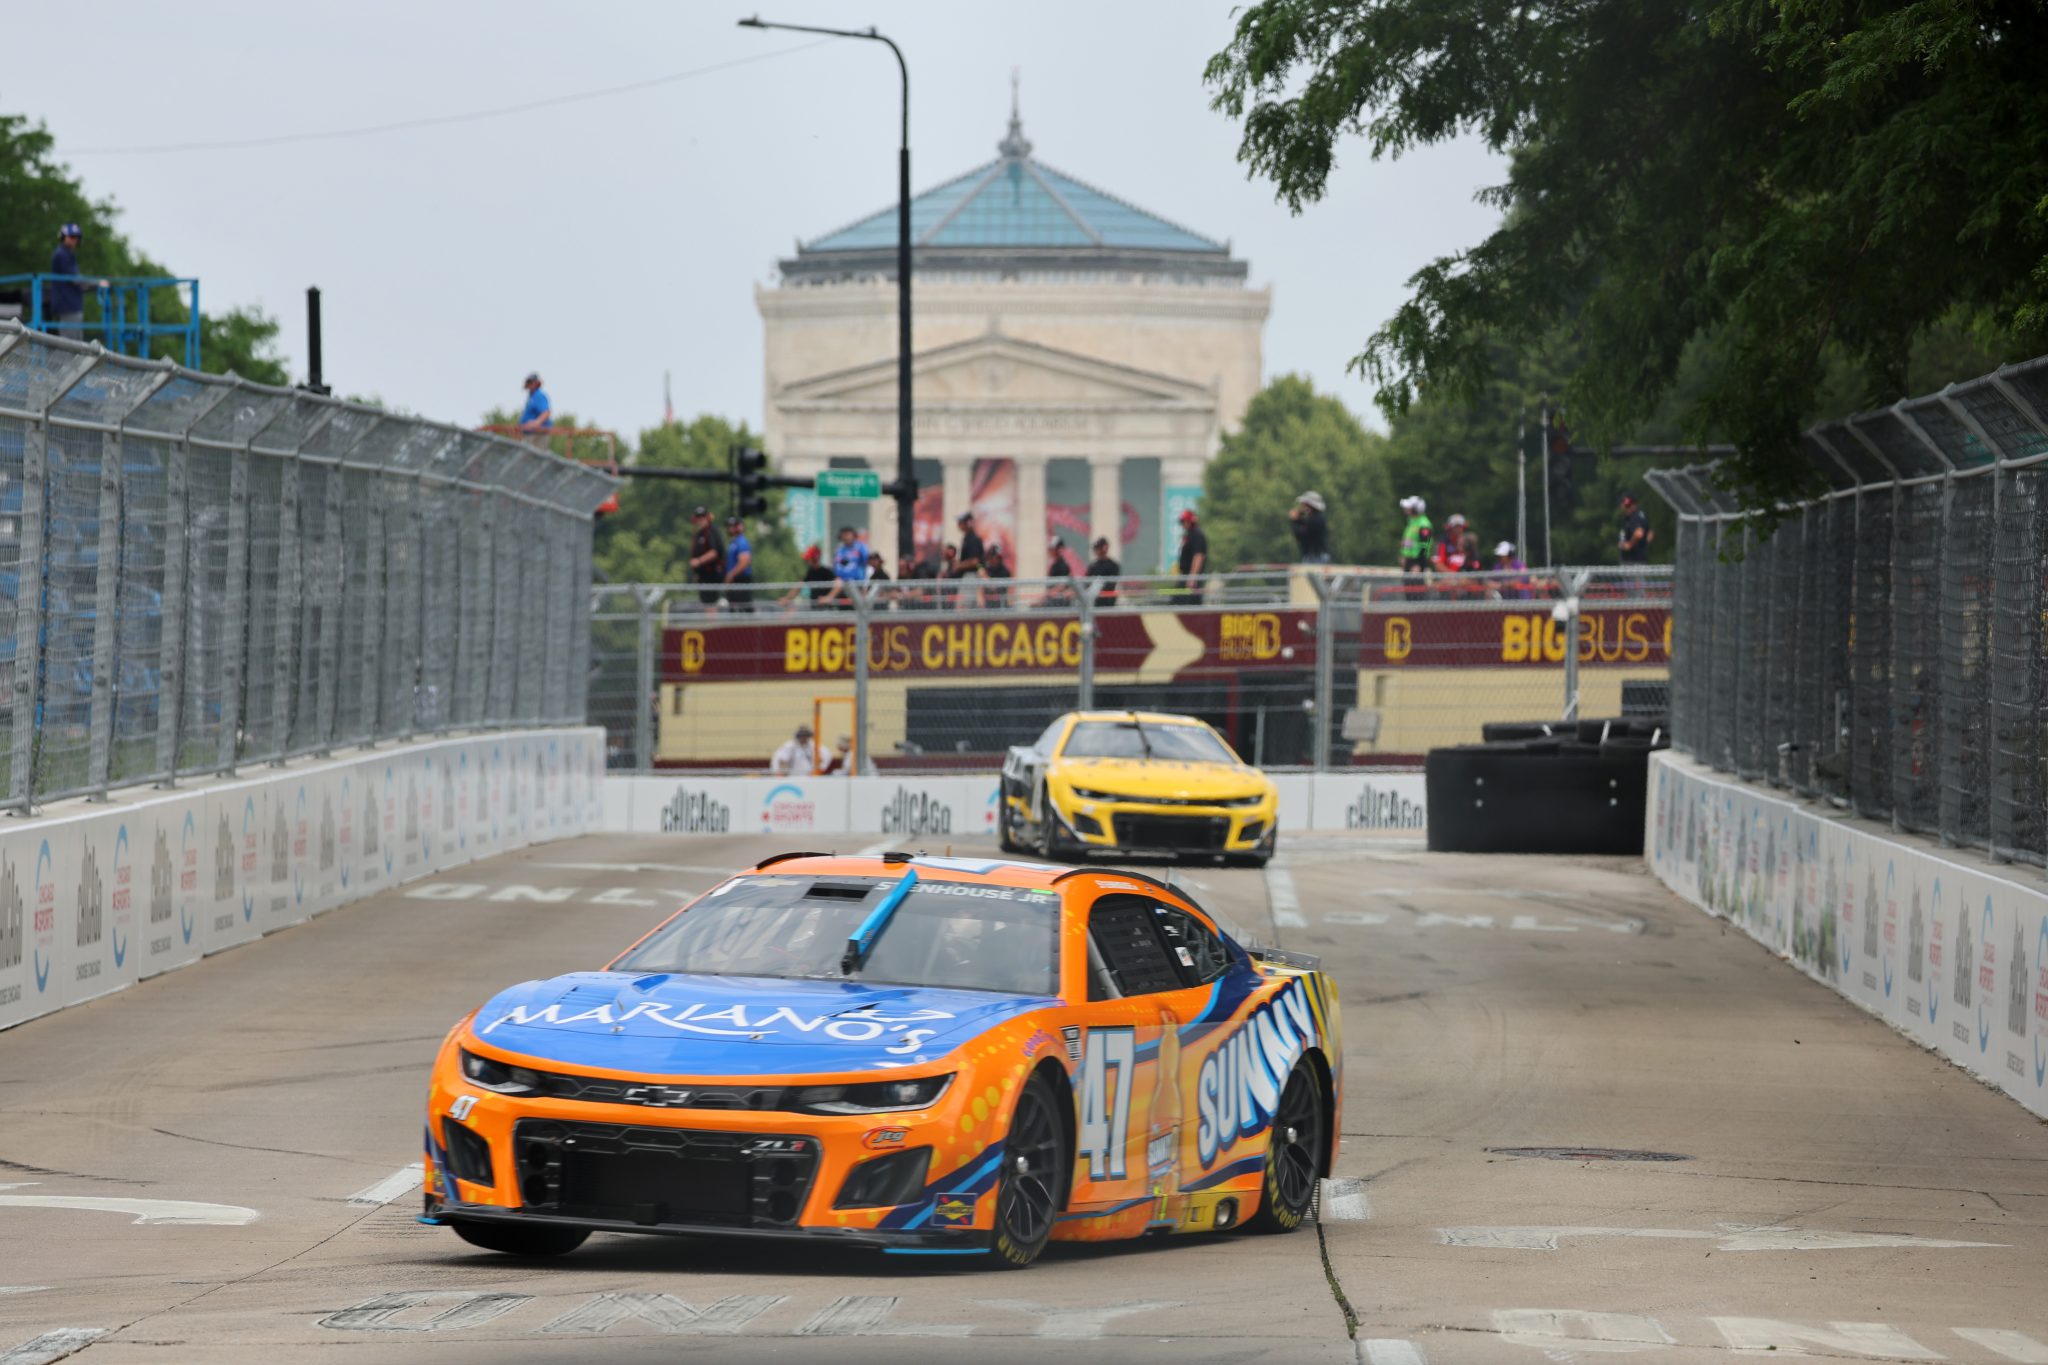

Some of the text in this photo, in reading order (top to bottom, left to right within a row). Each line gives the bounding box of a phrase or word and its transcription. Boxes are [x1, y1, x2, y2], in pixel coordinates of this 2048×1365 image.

[921, 621, 1083, 667] CHICAGO
[1017, 892, 1048, 904] JR
[482, 1001, 955, 1055] MARIANO'S
[1199, 978, 1317, 1168] SUNNY
[448, 1095, 478, 1121] 47
[1079, 1026, 1135, 1182] 47
[752, 1141, 806, 1152] ZL1
